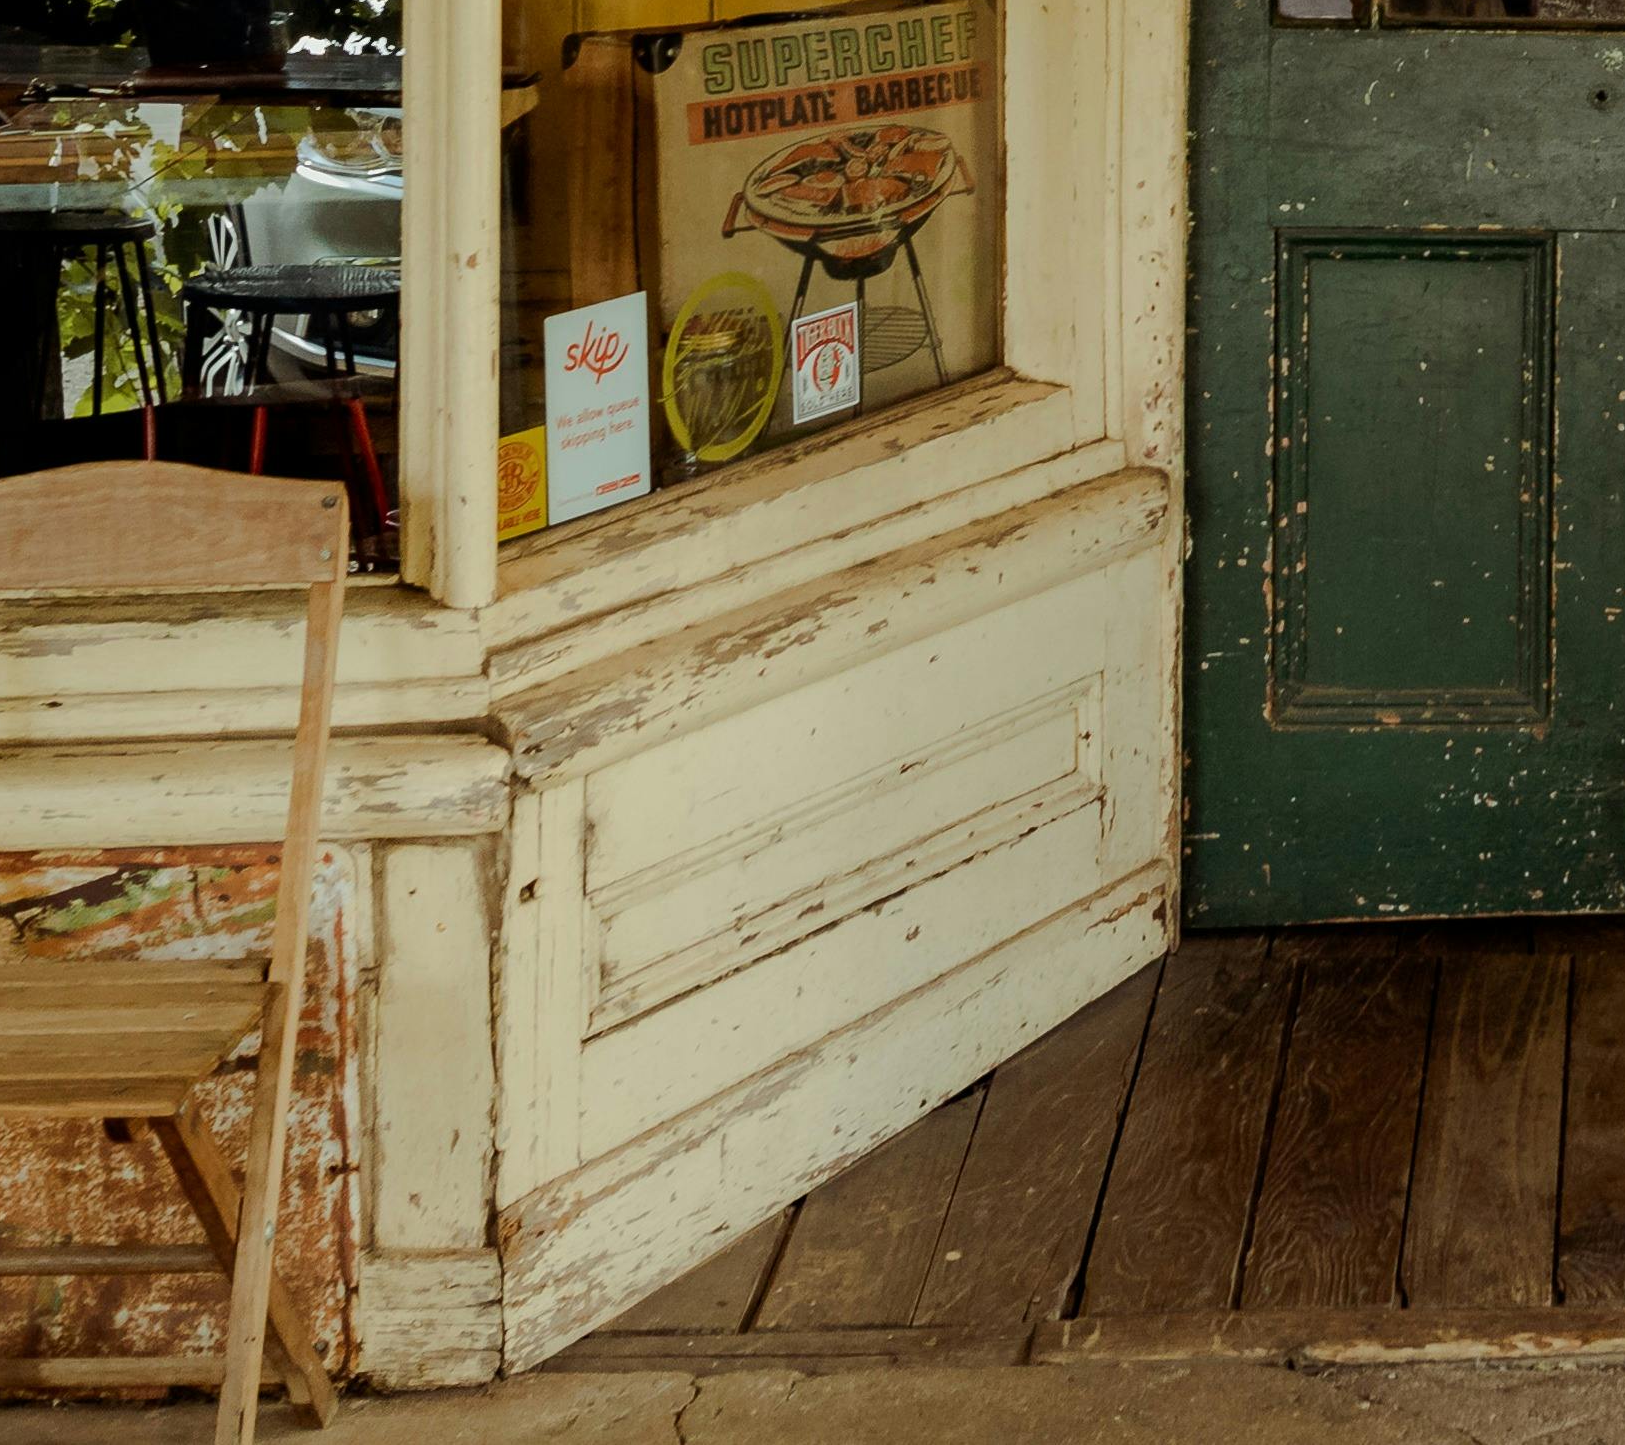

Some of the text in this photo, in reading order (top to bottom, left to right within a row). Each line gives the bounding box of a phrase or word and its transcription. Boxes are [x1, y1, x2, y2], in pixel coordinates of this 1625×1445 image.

[702, 12, 977, 95] SUPERCHEF
[702, 67, 984, 140] HOTPLATE BARBECUE
[564, 321, 630, 384] skip
[561, 426, 607, 451] skipping
